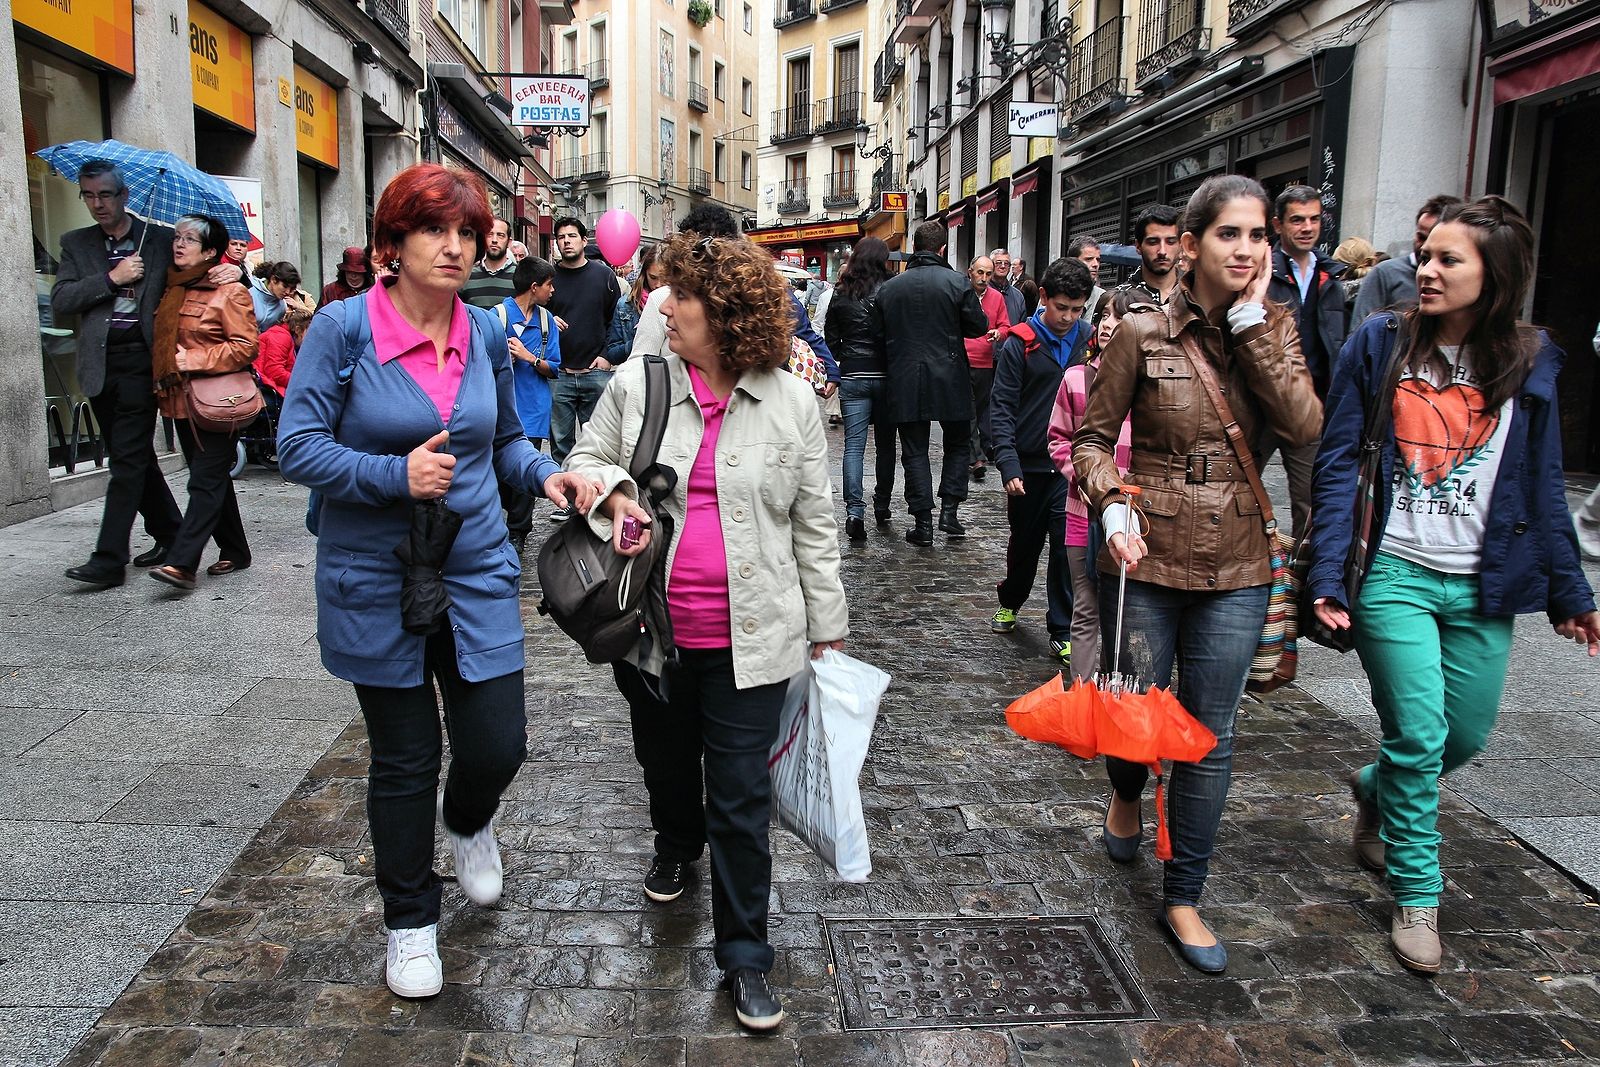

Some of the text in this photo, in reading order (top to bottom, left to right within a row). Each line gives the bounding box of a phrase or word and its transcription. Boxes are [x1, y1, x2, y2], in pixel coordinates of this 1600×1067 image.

[190, 22, 218, 65] ans
[295, 85, 314, 117] ans
[515, 82, 586, 103] CERVECERIA
[540, 95, 561, 105] BAR
[520, 106, 581, 121] POSTAS
[1392, 496, 1475, 516] SKETBAL
